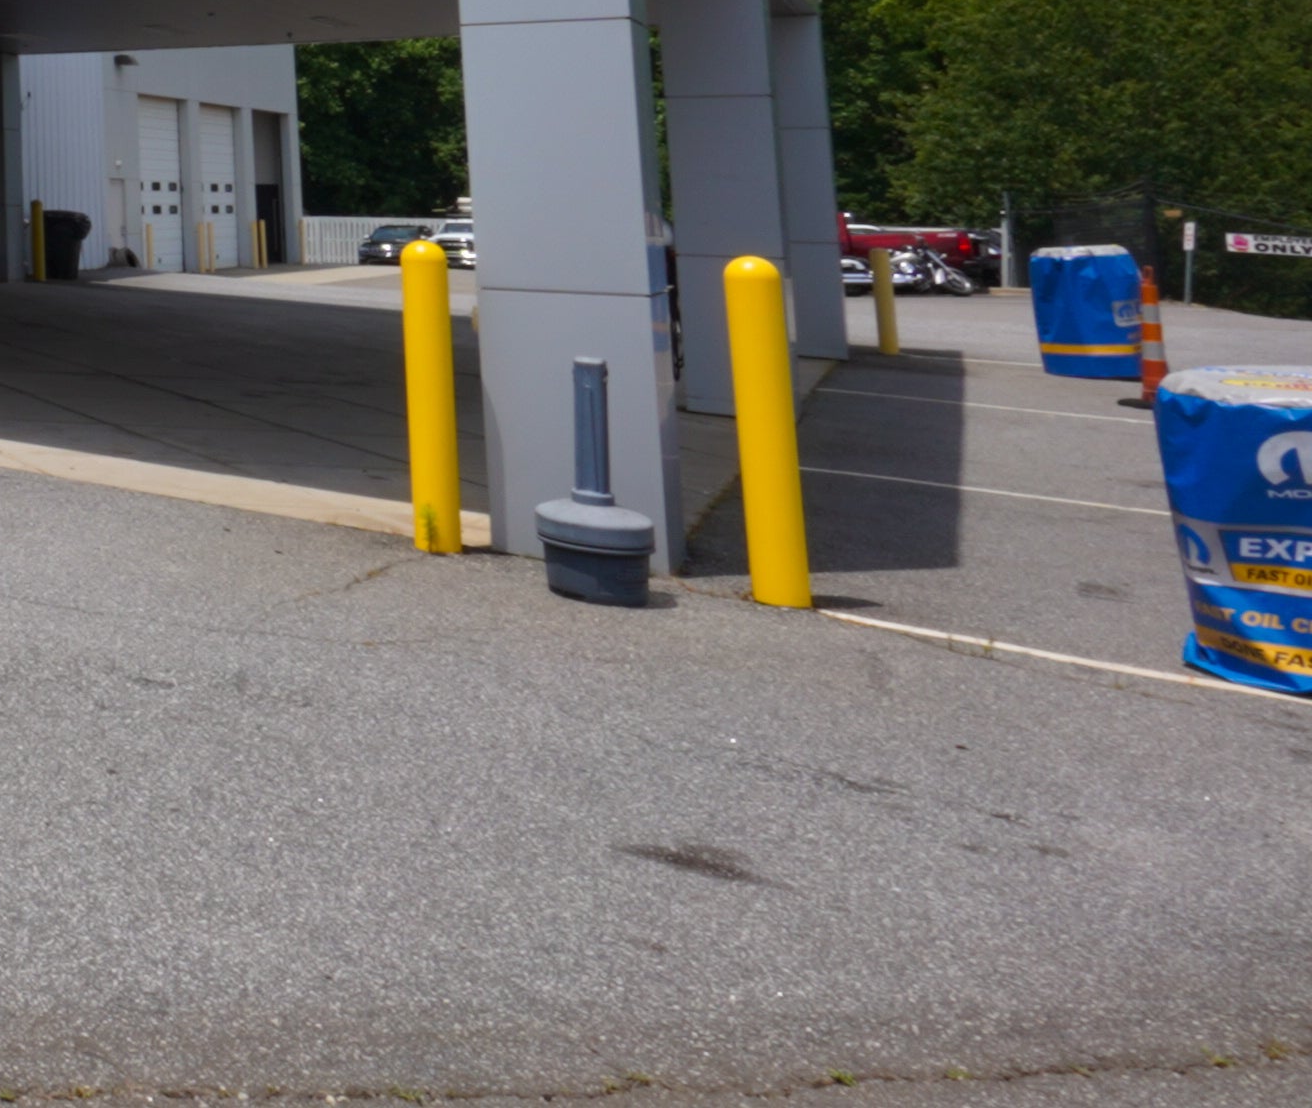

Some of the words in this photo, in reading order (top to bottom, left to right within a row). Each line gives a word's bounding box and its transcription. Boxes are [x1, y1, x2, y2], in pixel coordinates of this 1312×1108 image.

[1255, 243, 1312, 255] ONLY
[1239, 537, 1312, 562] EXP
[1247, 568, 1290, 583] FAST
[1241, 610, 1286, 630] OIL
